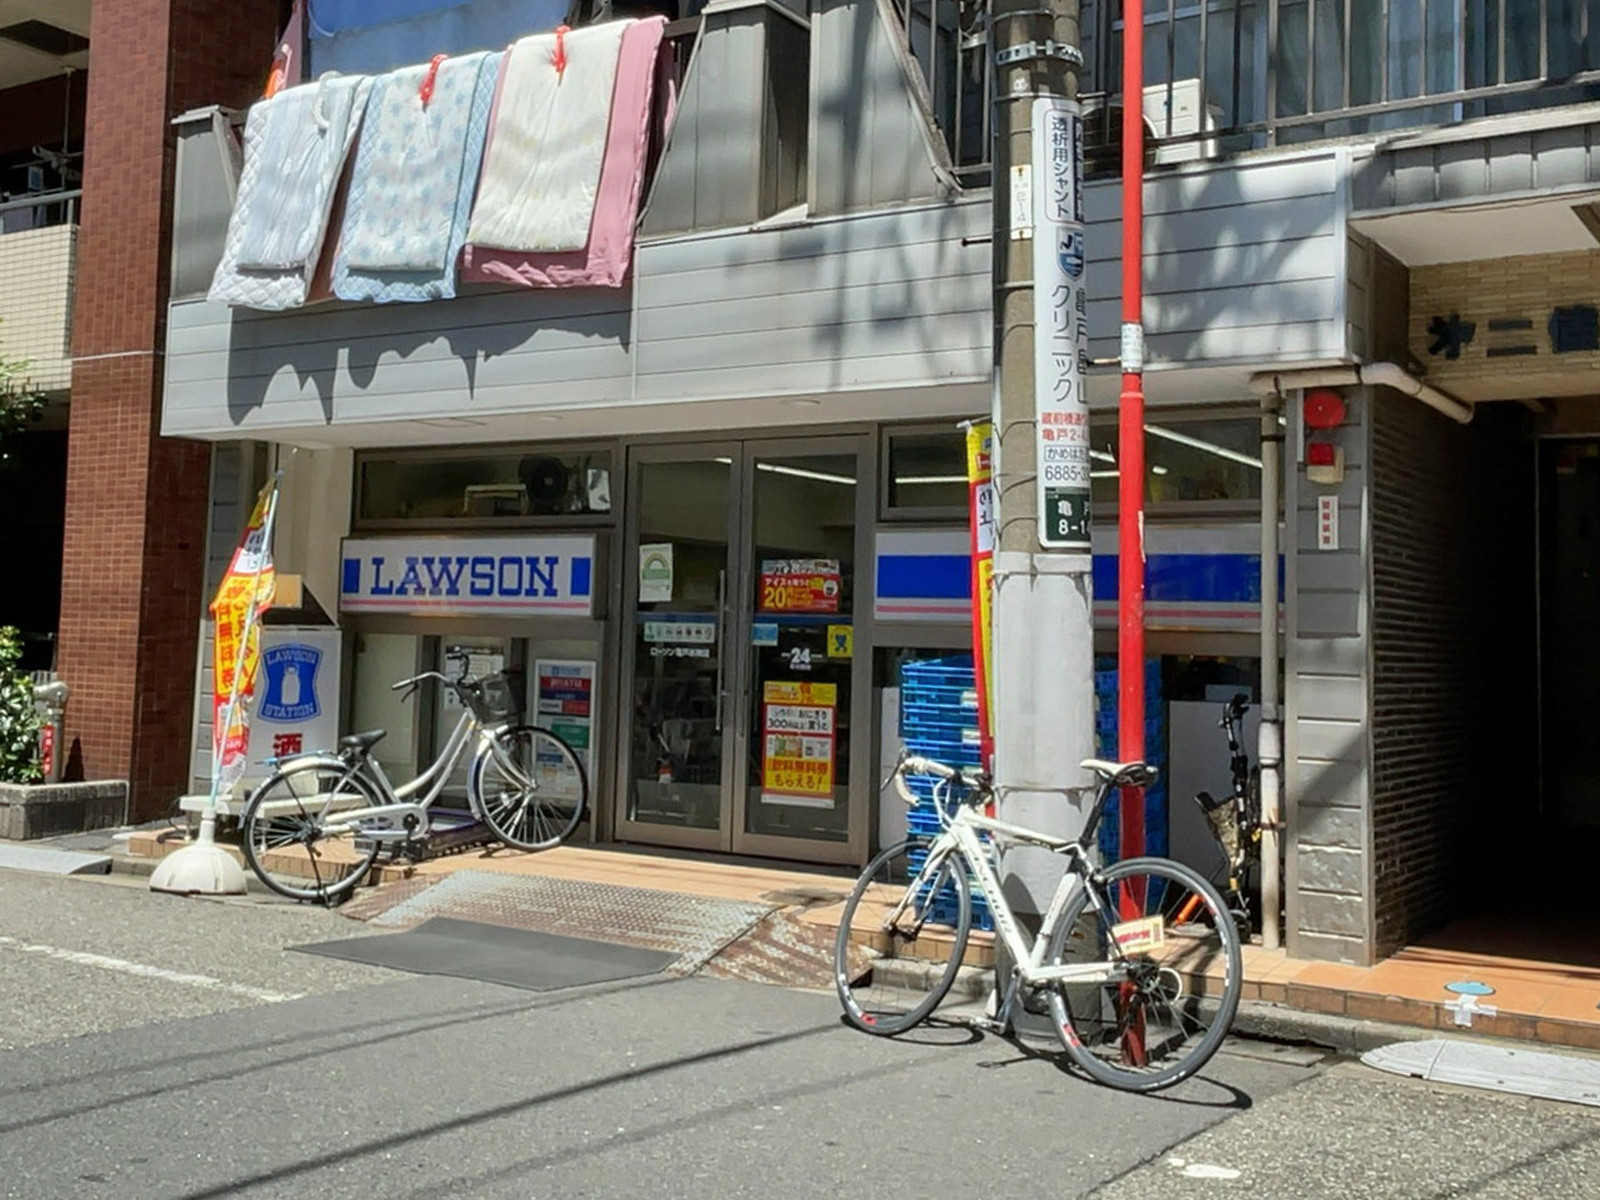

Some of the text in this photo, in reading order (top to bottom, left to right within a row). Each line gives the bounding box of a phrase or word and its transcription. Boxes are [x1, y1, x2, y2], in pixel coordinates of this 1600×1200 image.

[1052, 285, 1073, 402] クリニック
[370, 556, 559, 597] LAWSON
[790, 646, 811, 663] 24
[264, 702, 315, 719] STATION
[273, 733, 303, 757] 酒
